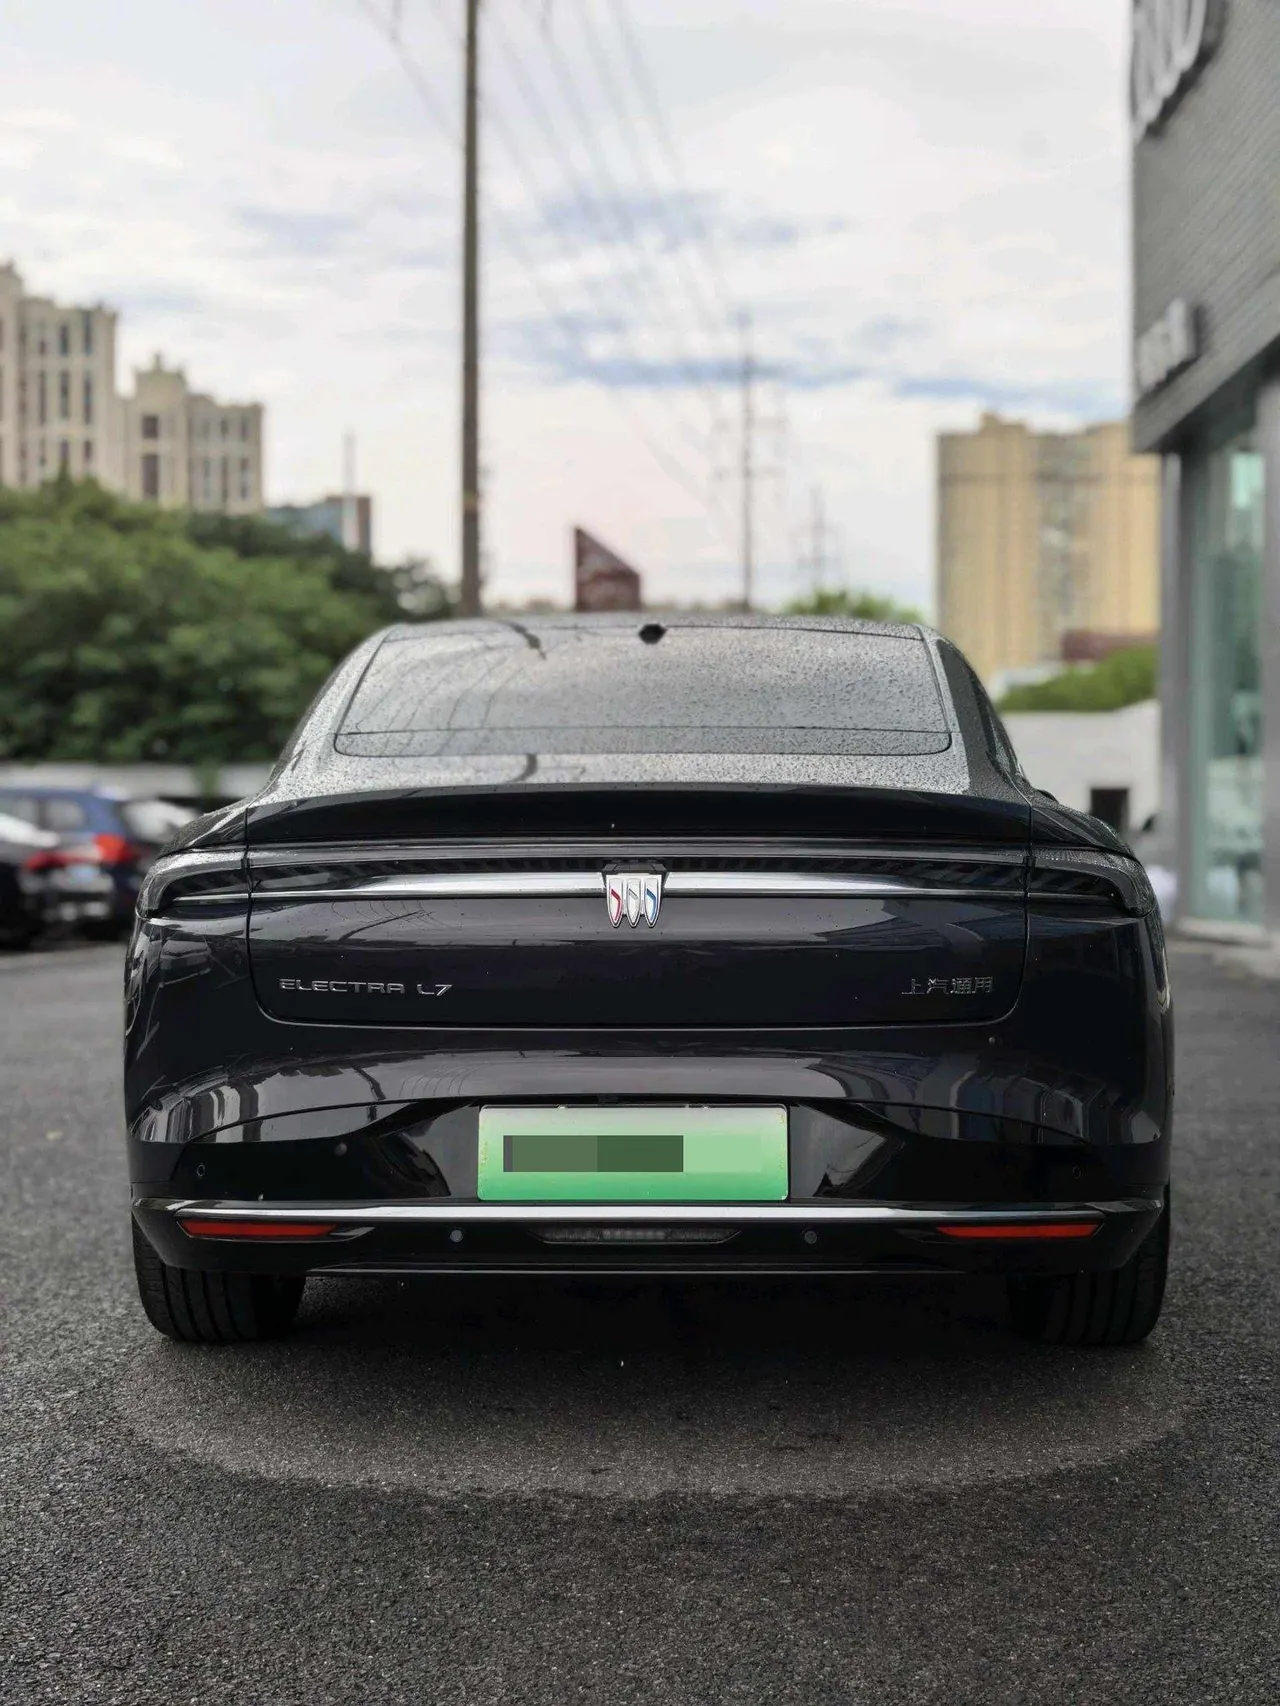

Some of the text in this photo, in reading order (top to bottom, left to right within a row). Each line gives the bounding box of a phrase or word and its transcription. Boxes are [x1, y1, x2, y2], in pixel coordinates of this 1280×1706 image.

[279, 978, 452, 996] ELECTRA L7
[901, 976, 993, 995] 上汽通用
